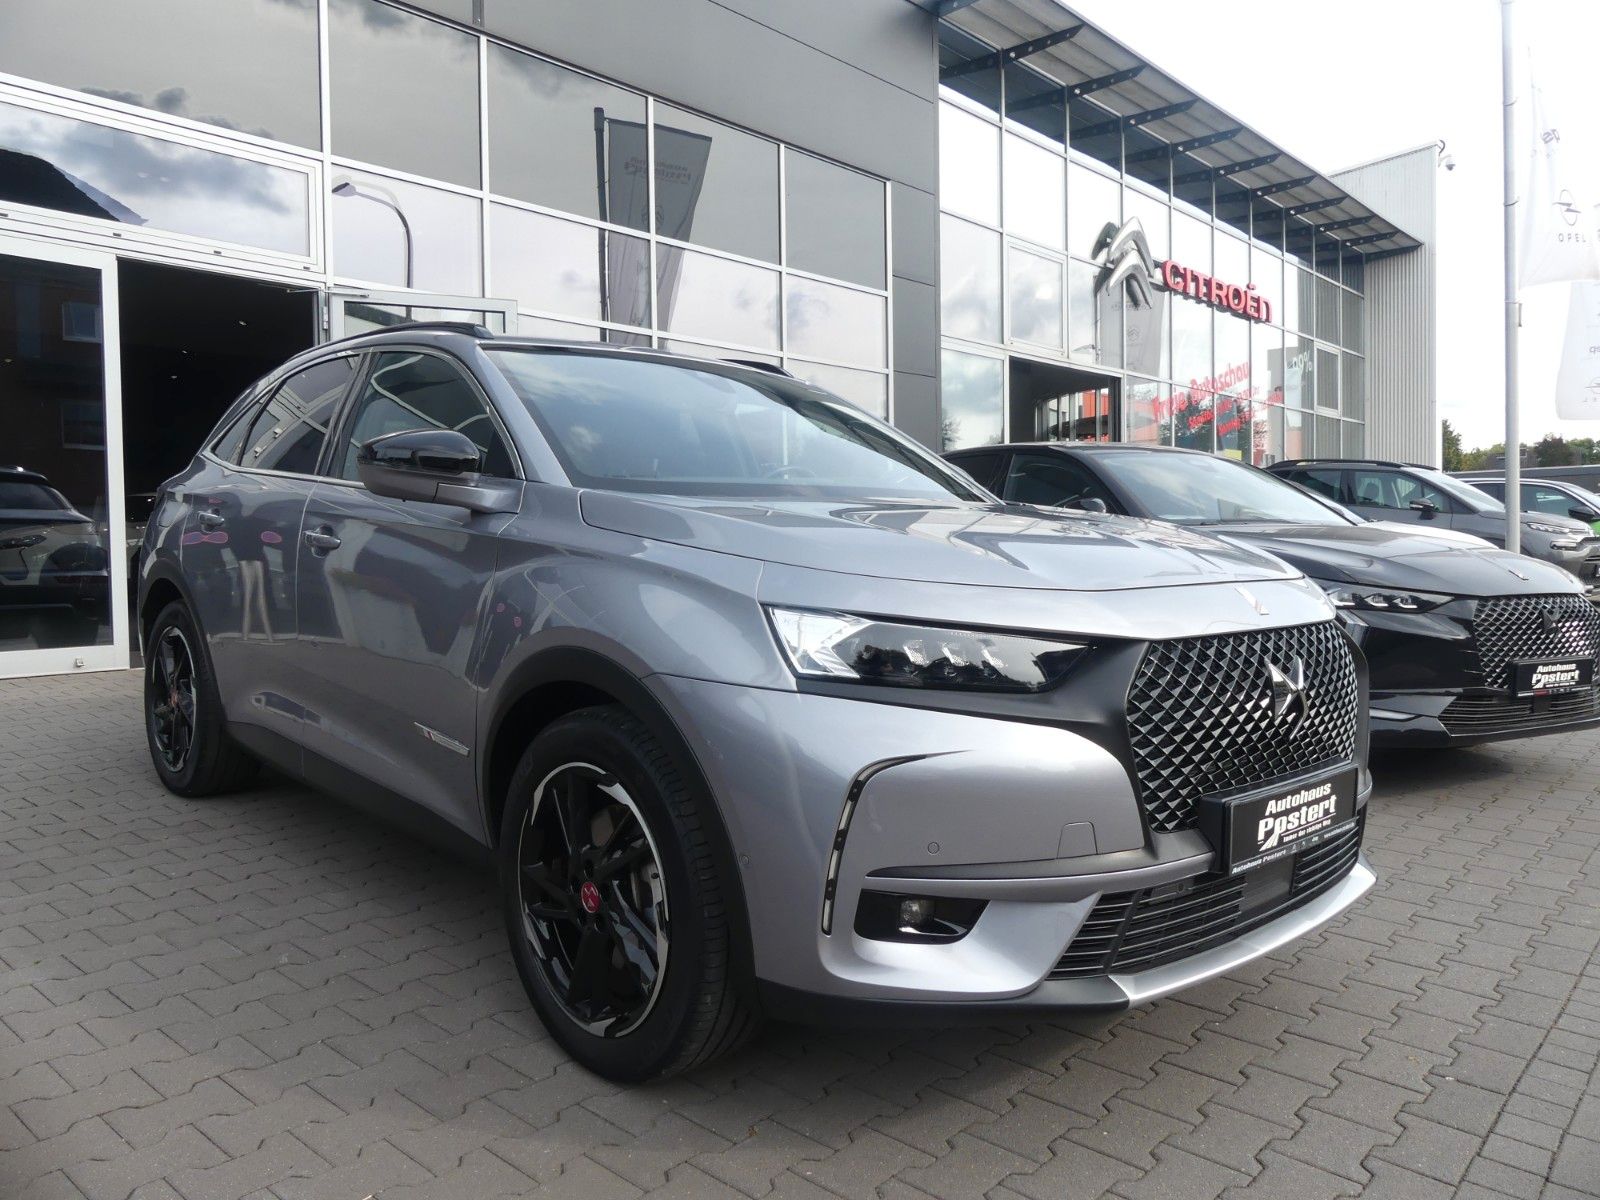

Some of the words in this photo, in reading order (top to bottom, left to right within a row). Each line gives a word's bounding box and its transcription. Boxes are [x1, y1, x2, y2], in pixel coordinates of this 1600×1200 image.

[1557, 232, 1587, 243] OPEL
[1536, 663, 1577, 673] Autohaus
[1265, 783, 1332, 816] Autohaus
[1257, 794, 1338, 850] Postert
